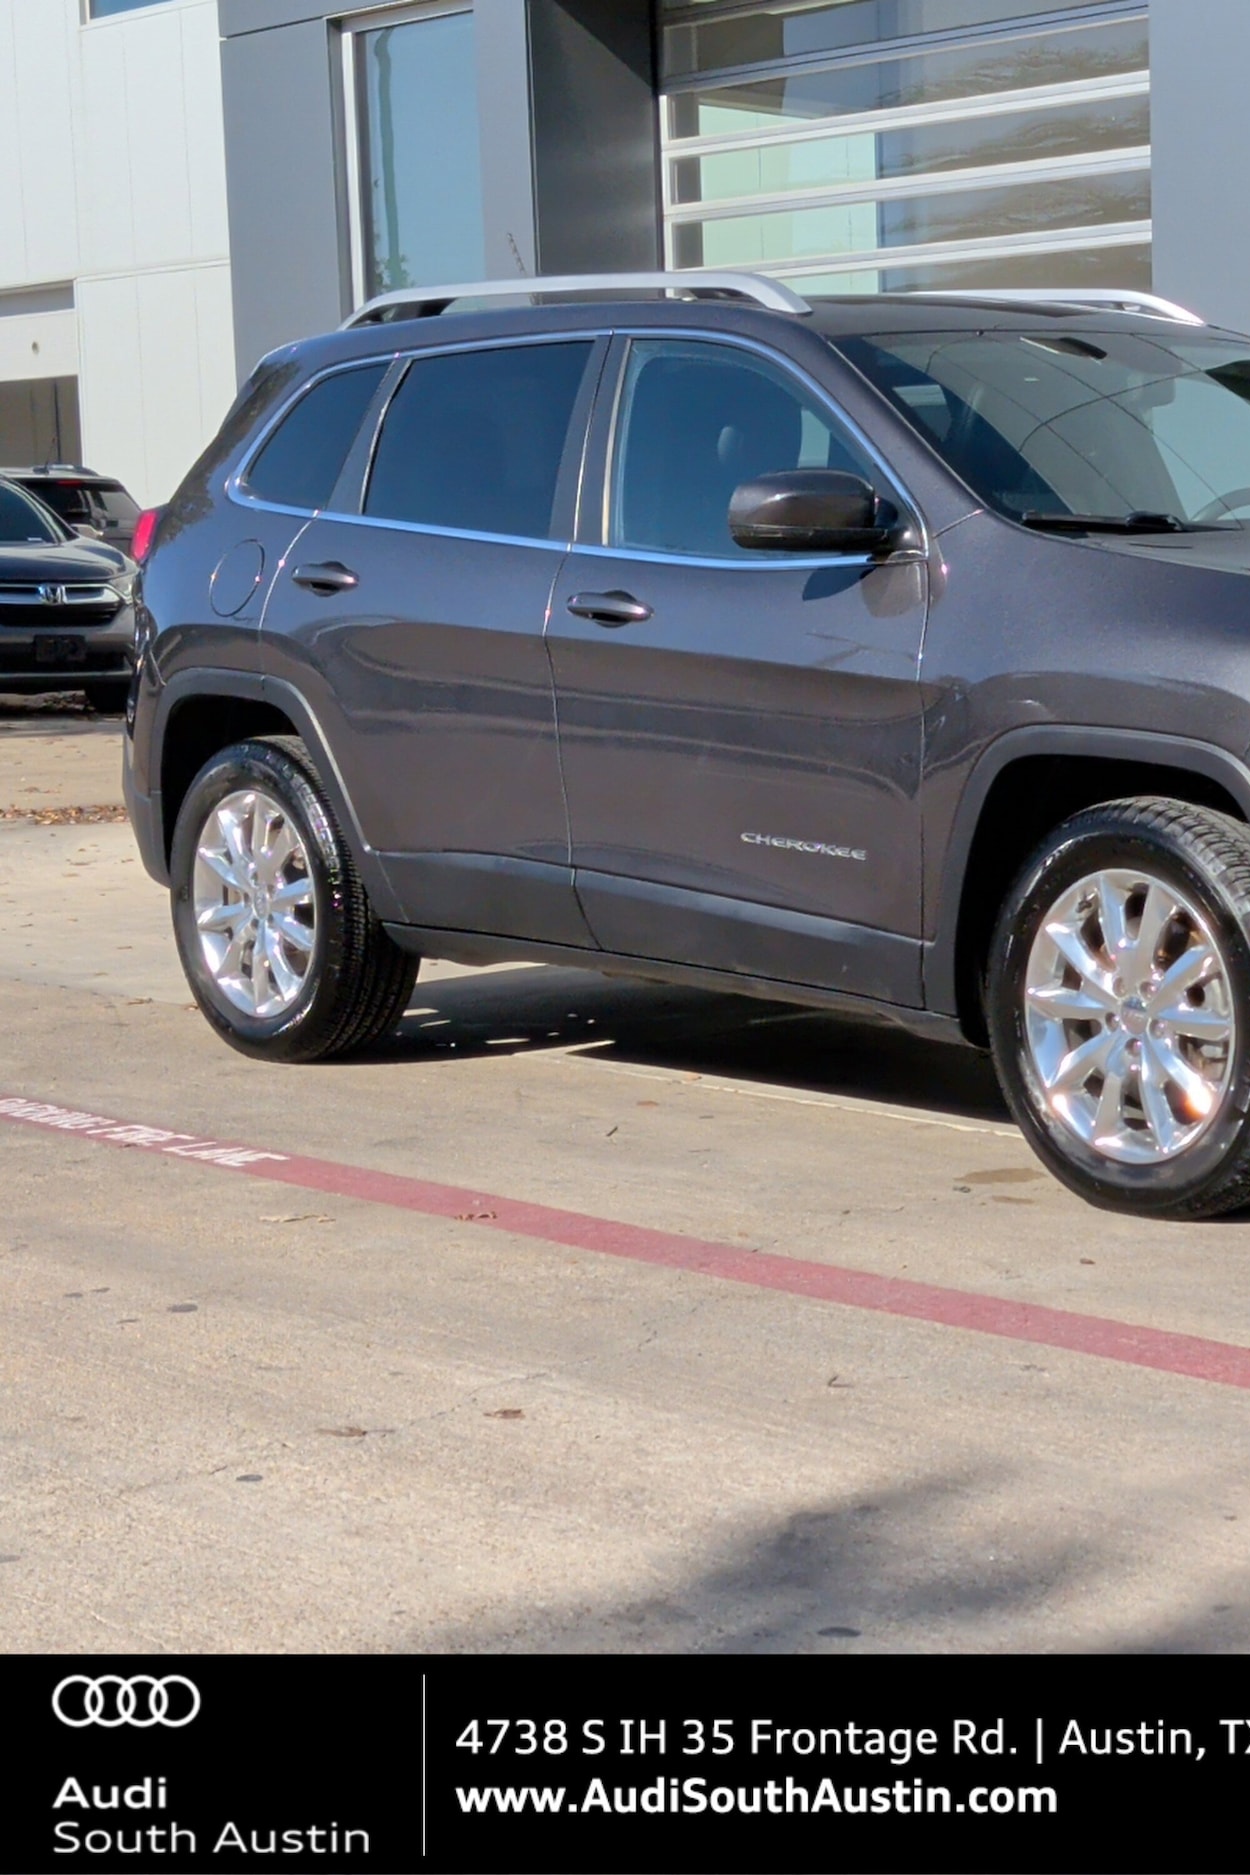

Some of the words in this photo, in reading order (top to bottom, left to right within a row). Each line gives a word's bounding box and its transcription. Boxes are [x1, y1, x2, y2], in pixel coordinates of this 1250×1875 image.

[740, 832, 867, 861] CHEROKEE
[86, 1125, 195, 1146] FIRE
[162, 1141, 290, 1166] LANE
